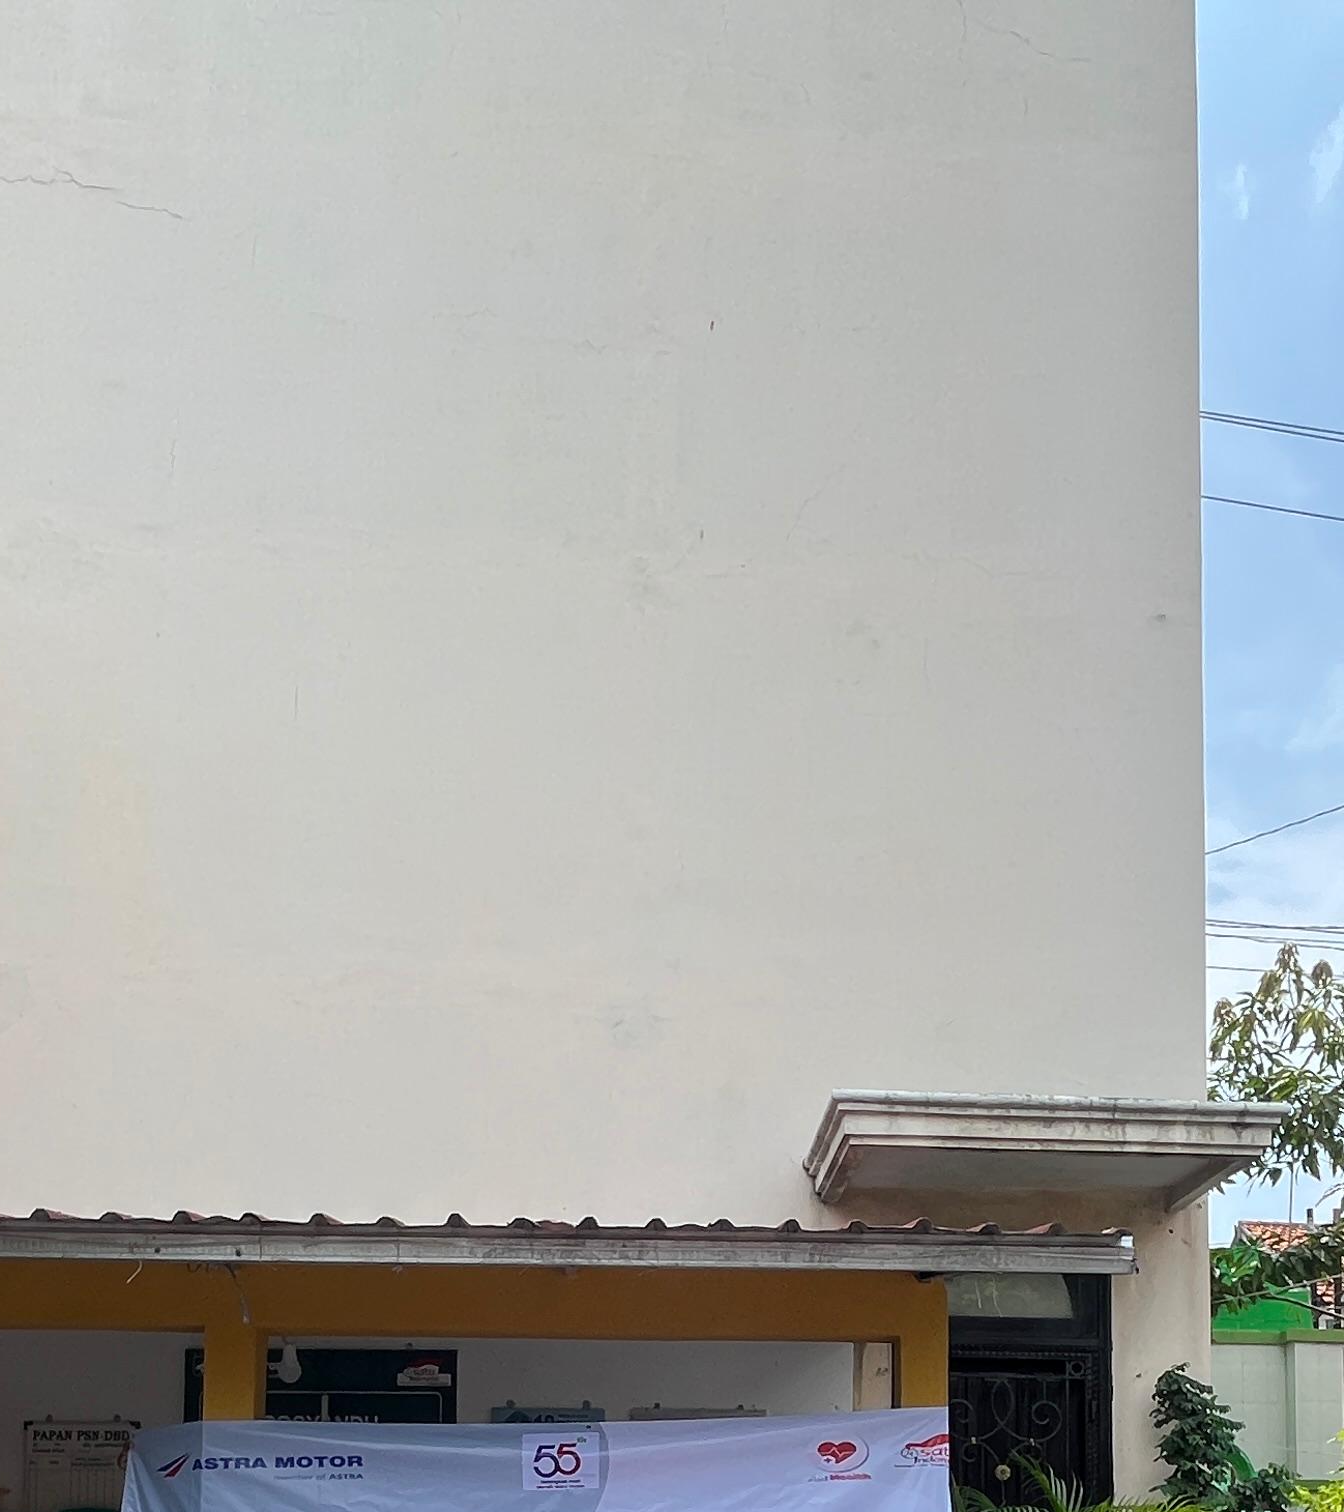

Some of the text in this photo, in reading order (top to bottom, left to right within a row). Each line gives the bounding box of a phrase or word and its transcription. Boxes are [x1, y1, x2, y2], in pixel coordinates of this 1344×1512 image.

[32, 1430, 73, 1441] PAPAN
[192, 1455, 364, 1471] ASTRA MOTOR
[533, 1443, 581, 1478] 55
